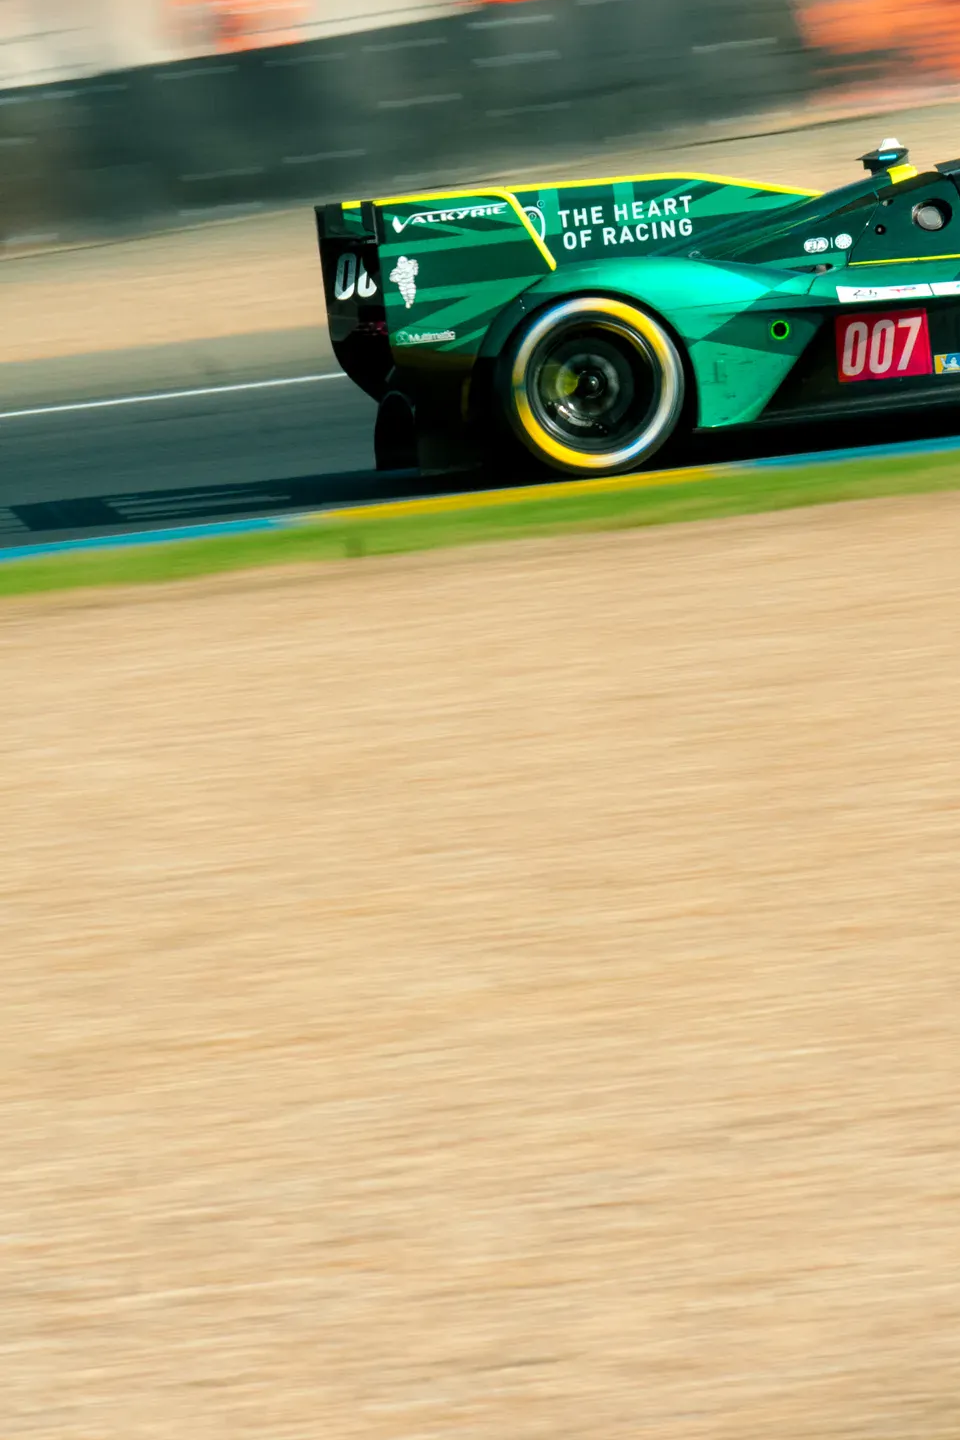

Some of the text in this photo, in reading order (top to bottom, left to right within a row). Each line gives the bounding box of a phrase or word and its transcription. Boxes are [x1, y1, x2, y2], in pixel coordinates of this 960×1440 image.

[392, 202, 508, 234] VALKYRIE
[557, 195, 692, 228] THE HEART
[563, 218, 693, 250] OF RACING
[408, 329, 456, 343] Multimatic
[842, 316, 922, 377] 007
